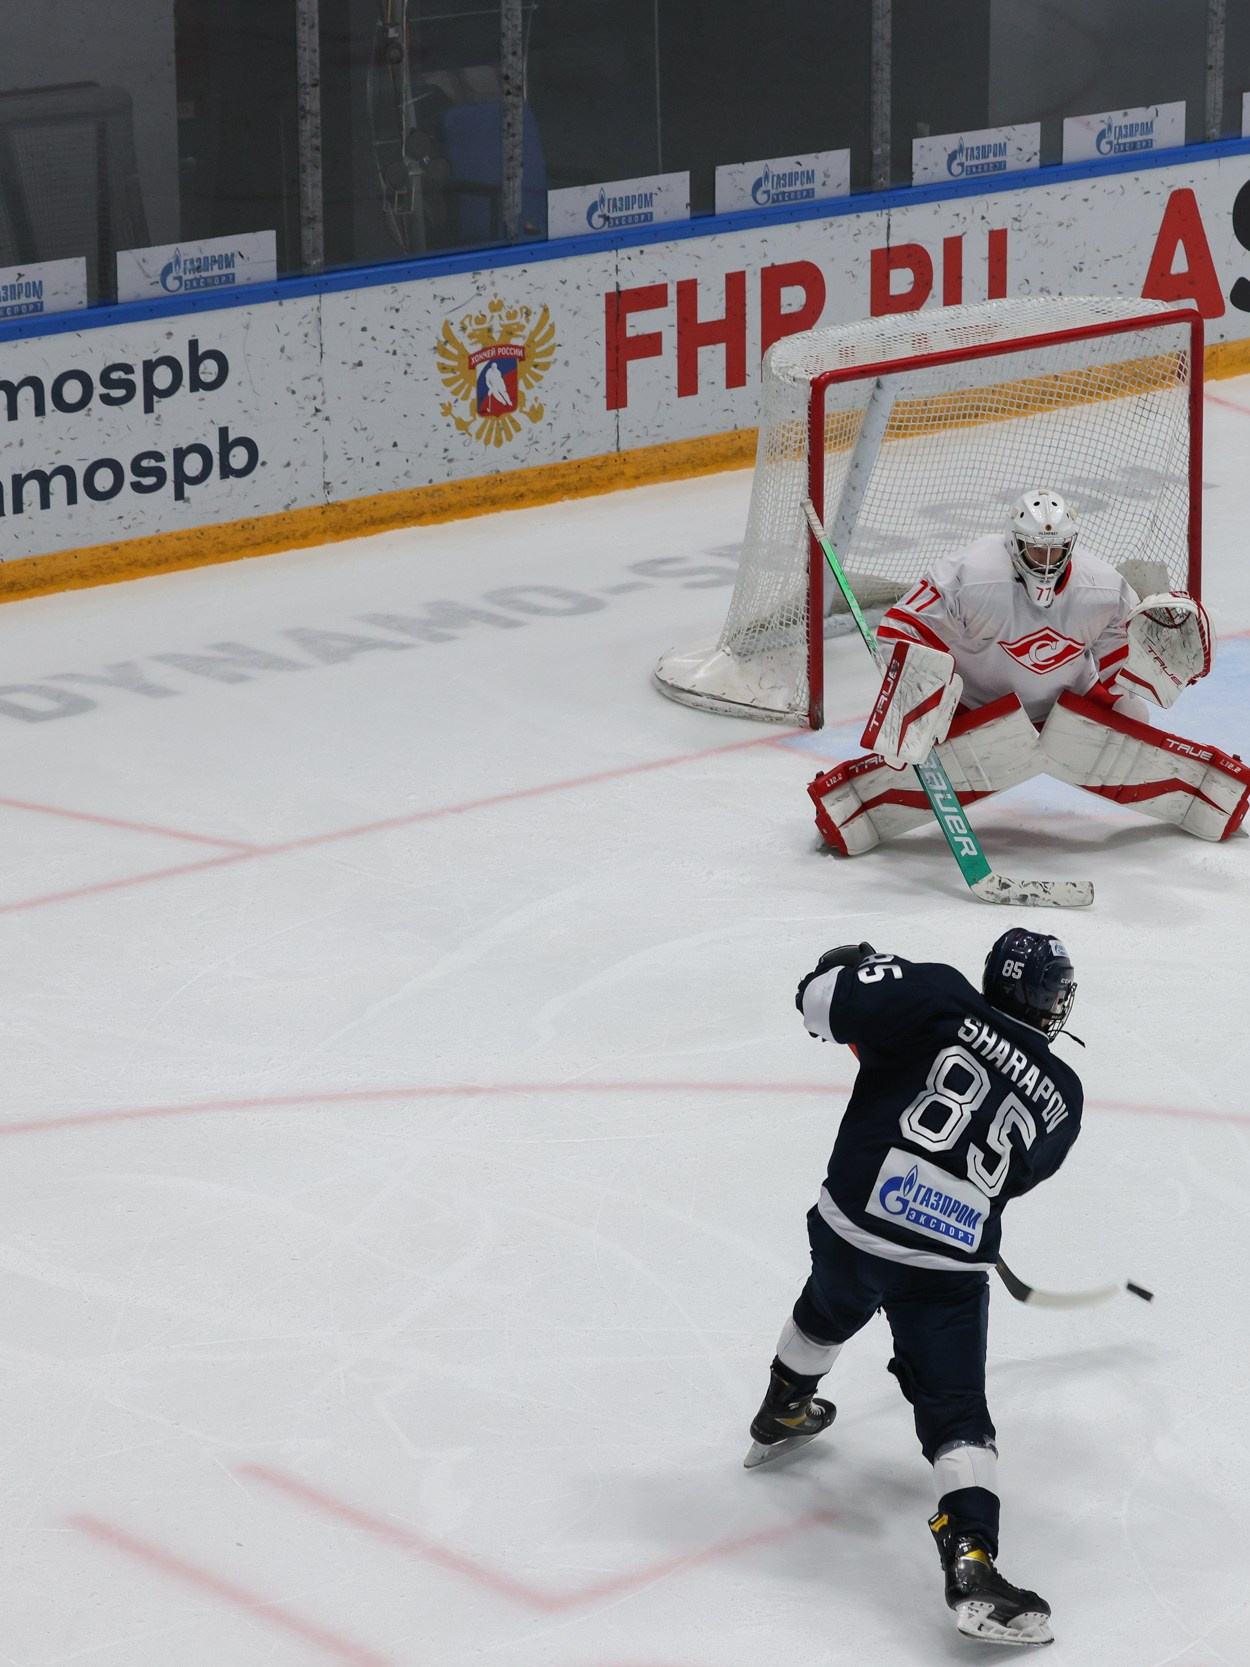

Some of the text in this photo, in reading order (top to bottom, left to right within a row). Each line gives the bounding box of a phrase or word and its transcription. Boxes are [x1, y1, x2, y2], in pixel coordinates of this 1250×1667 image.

[1114, 121, 1154, 140] ГАЗПРОМ
[965, 141, 1007, 161] ГАЗПРОМ
[771, 169, 815, 190] ГАЗПРОМ
[607, 193, 653, 213] ГАЗПРОМ
[608, 212, 653, 228] ЭКСПОРТ
[183, 253, 235, 275] ГАЗПРОМ
[0, 280, 43, 302] ЗПРОМ
[0, 301, 43, 317] СПОРТ
[497, 347, 523, 357] РОССИИ
[0, 338, 229, 422] mospb
[0, 426, 259, 517] mospb
[906, 579, 941, 612] 77
[1036, 587, 1052, 601] 77
[1148, 645, 1182, 686] TRUE
[868, 658, 900, 732] TRUE
[1166, 738, 1213, 761] TRUE
[849, 755, 884, 773] TR
[1001, 959, 1025, 980] 85
[957, 1015, 1069, 1134] SHARAPOV
[899, 1045, 1037, 1199] 85
[912, 1183, 982, 1230] ГАЗПРОМ
[908, 1209, 974, 1244] ЭКСПОРТ
